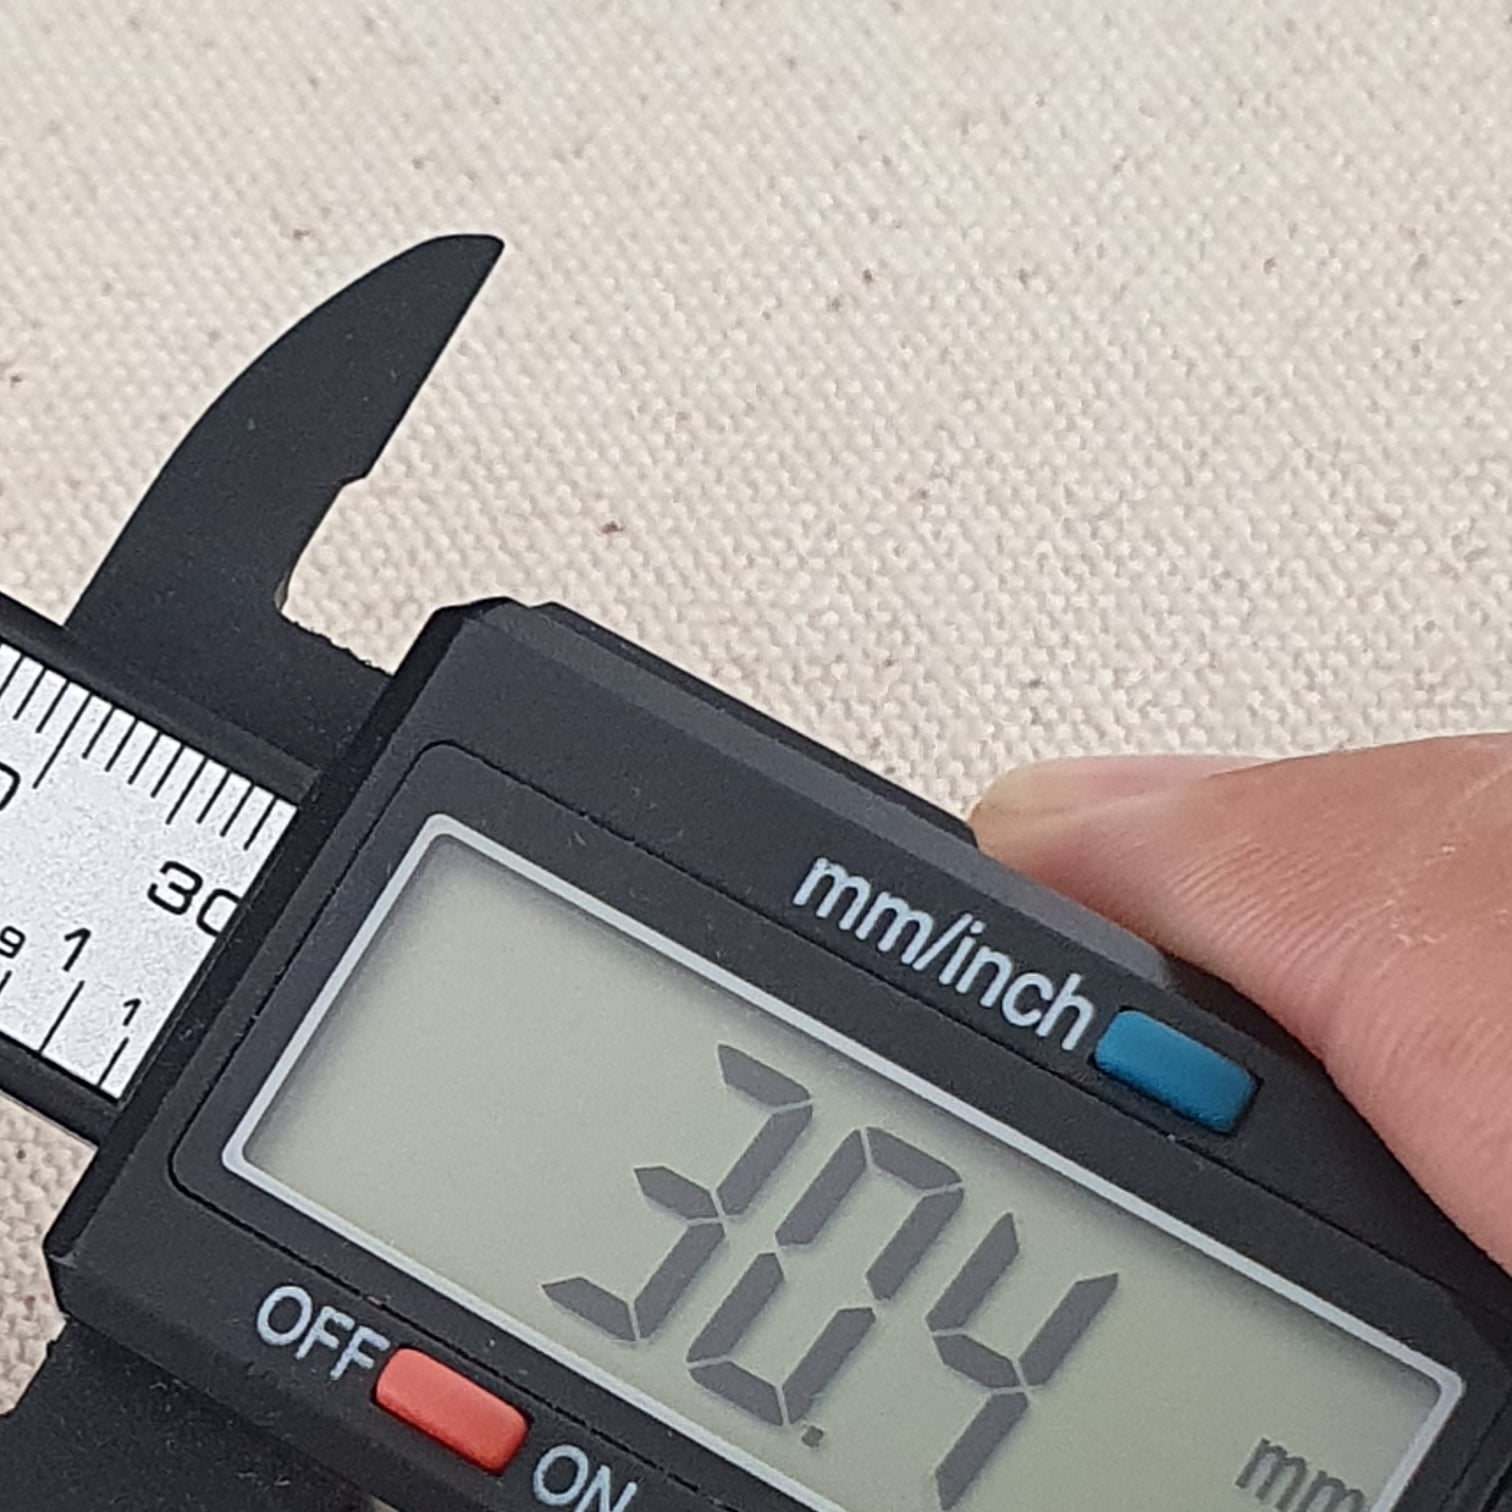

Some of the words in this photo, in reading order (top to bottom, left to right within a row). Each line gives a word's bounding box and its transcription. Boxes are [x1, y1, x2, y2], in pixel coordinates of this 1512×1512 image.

[62, 927, 91, 972] 1
[122, 998, 142, 1027] 1
[792, 855, 1095, 1052] mm/inch
[256, 1285, 391, 1381] OFF
[540, 1043, 1120, 1512] 30.4
